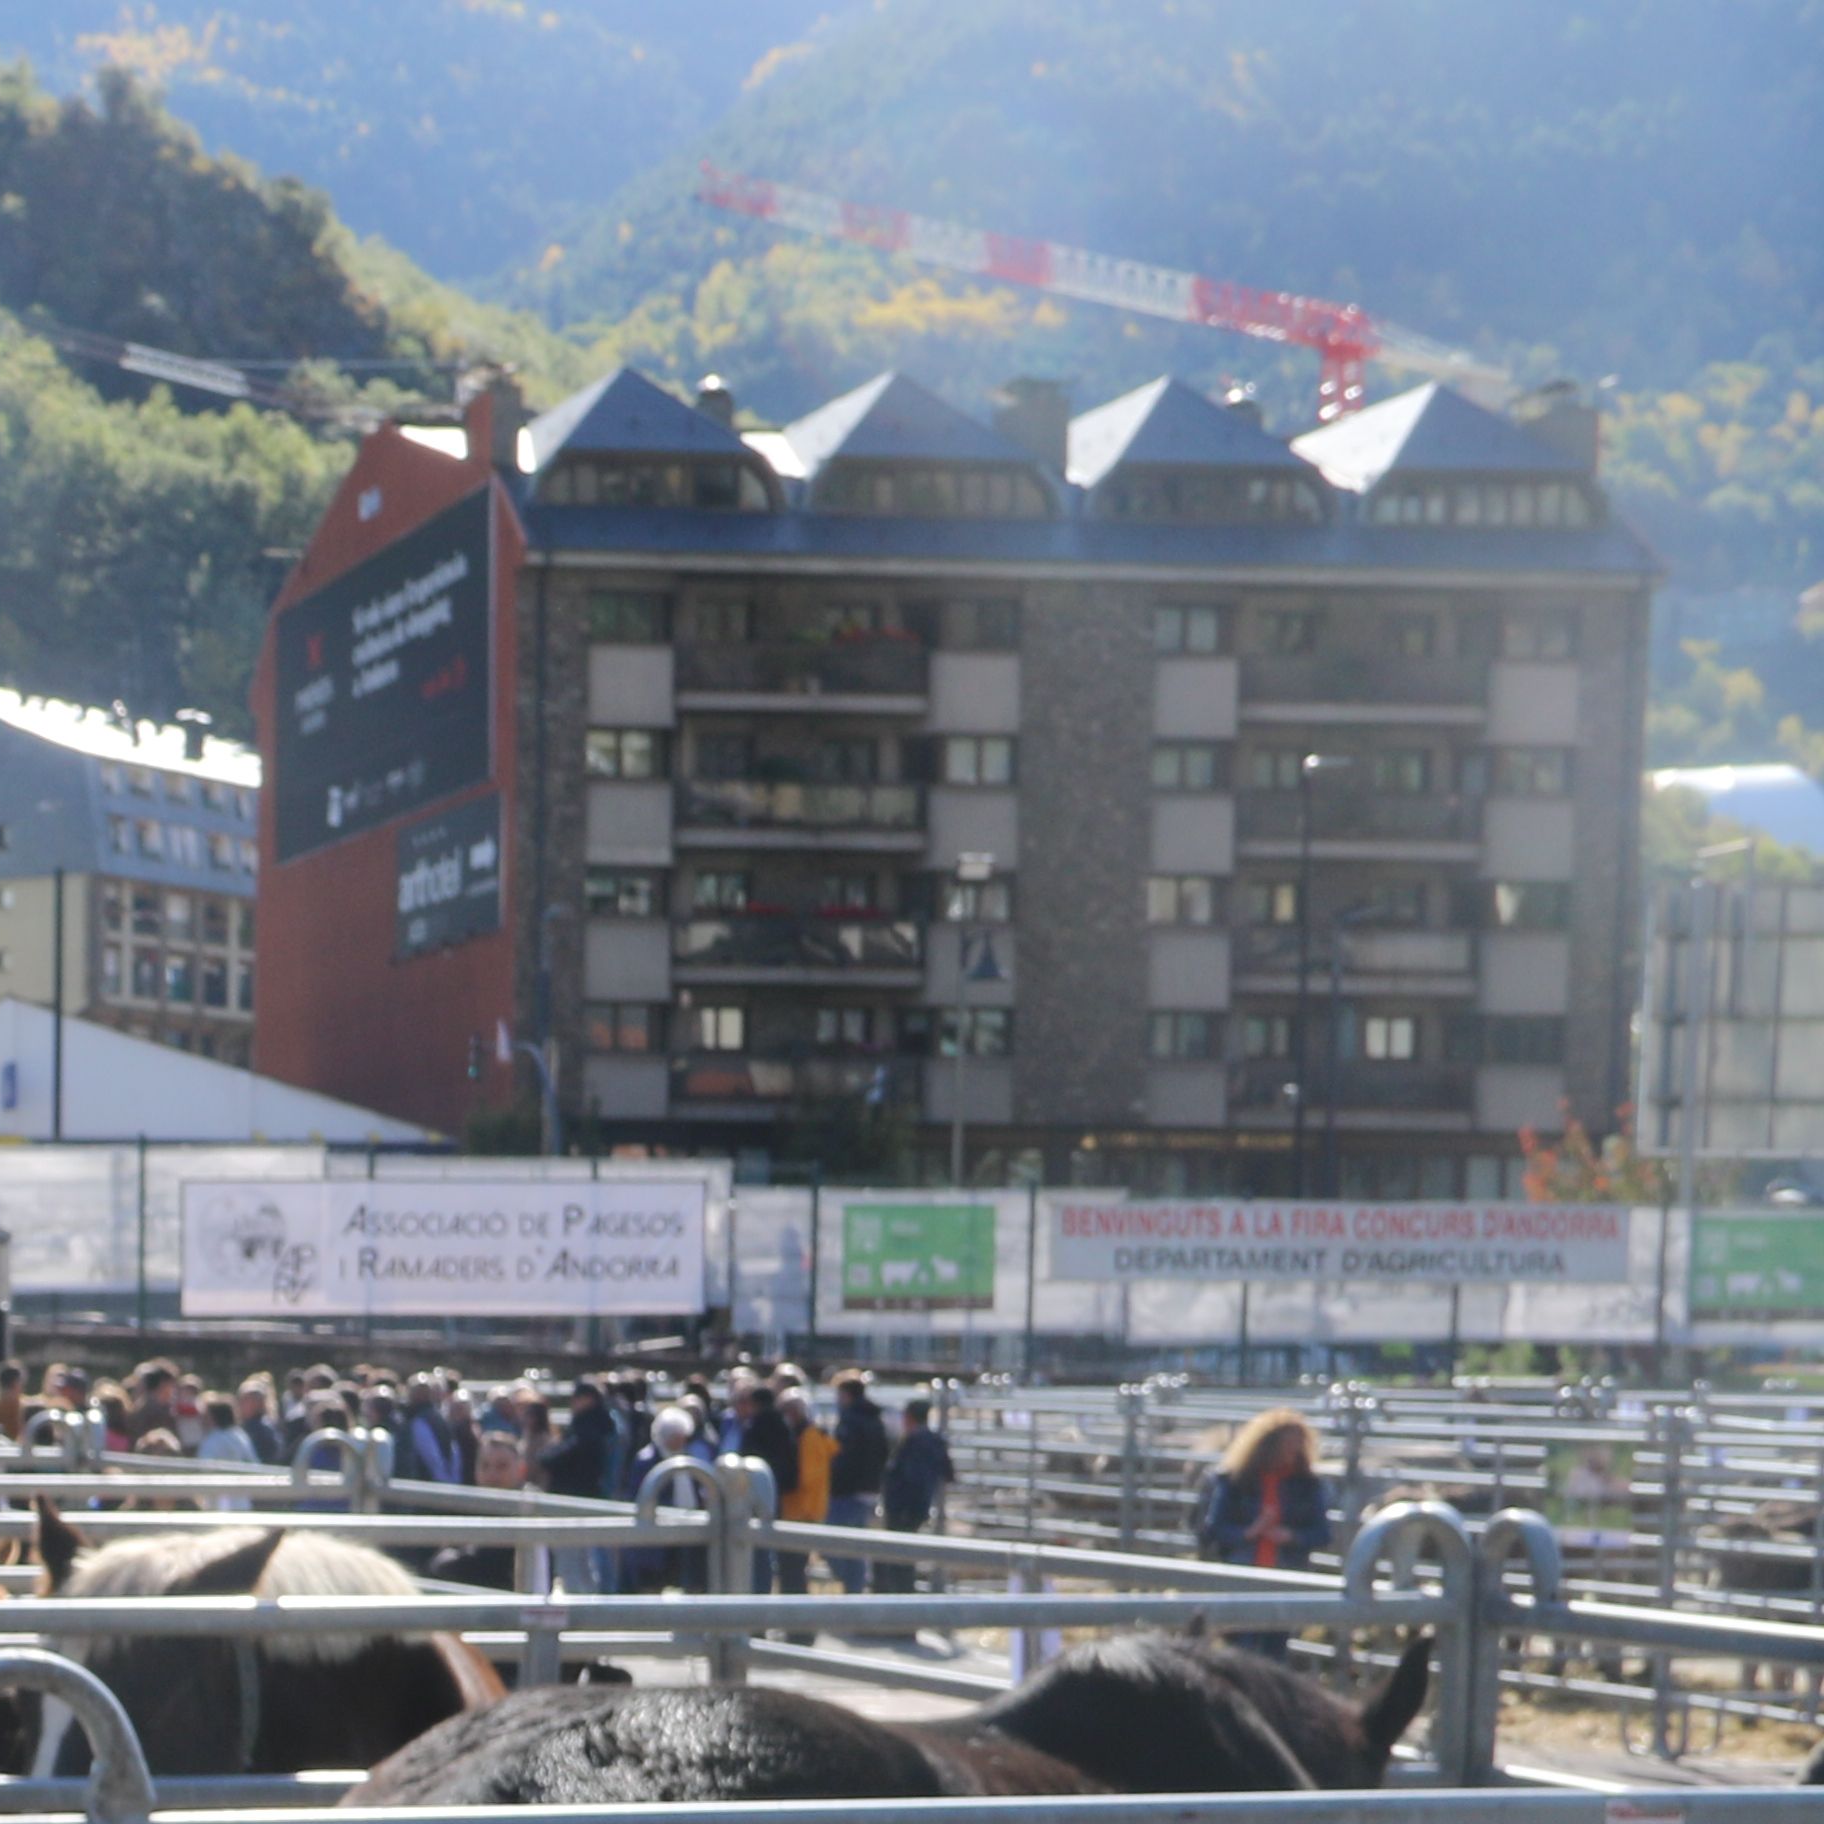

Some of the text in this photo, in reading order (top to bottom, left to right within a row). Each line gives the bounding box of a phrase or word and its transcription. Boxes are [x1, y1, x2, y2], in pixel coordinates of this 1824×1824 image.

[518, 1211, 549, 1238] DE
[561, 1202, 686, 1239] PAGESOS
[1060, 1205, 1619, 1240] BENVINGUTS A LA FIRA CONCURS D'ANDORRA
[358, 1246, 504, 1281] RAMADERS
[1114, 1247, 1566, 1275] DEPARTAMENT D'AGRICULTURA
